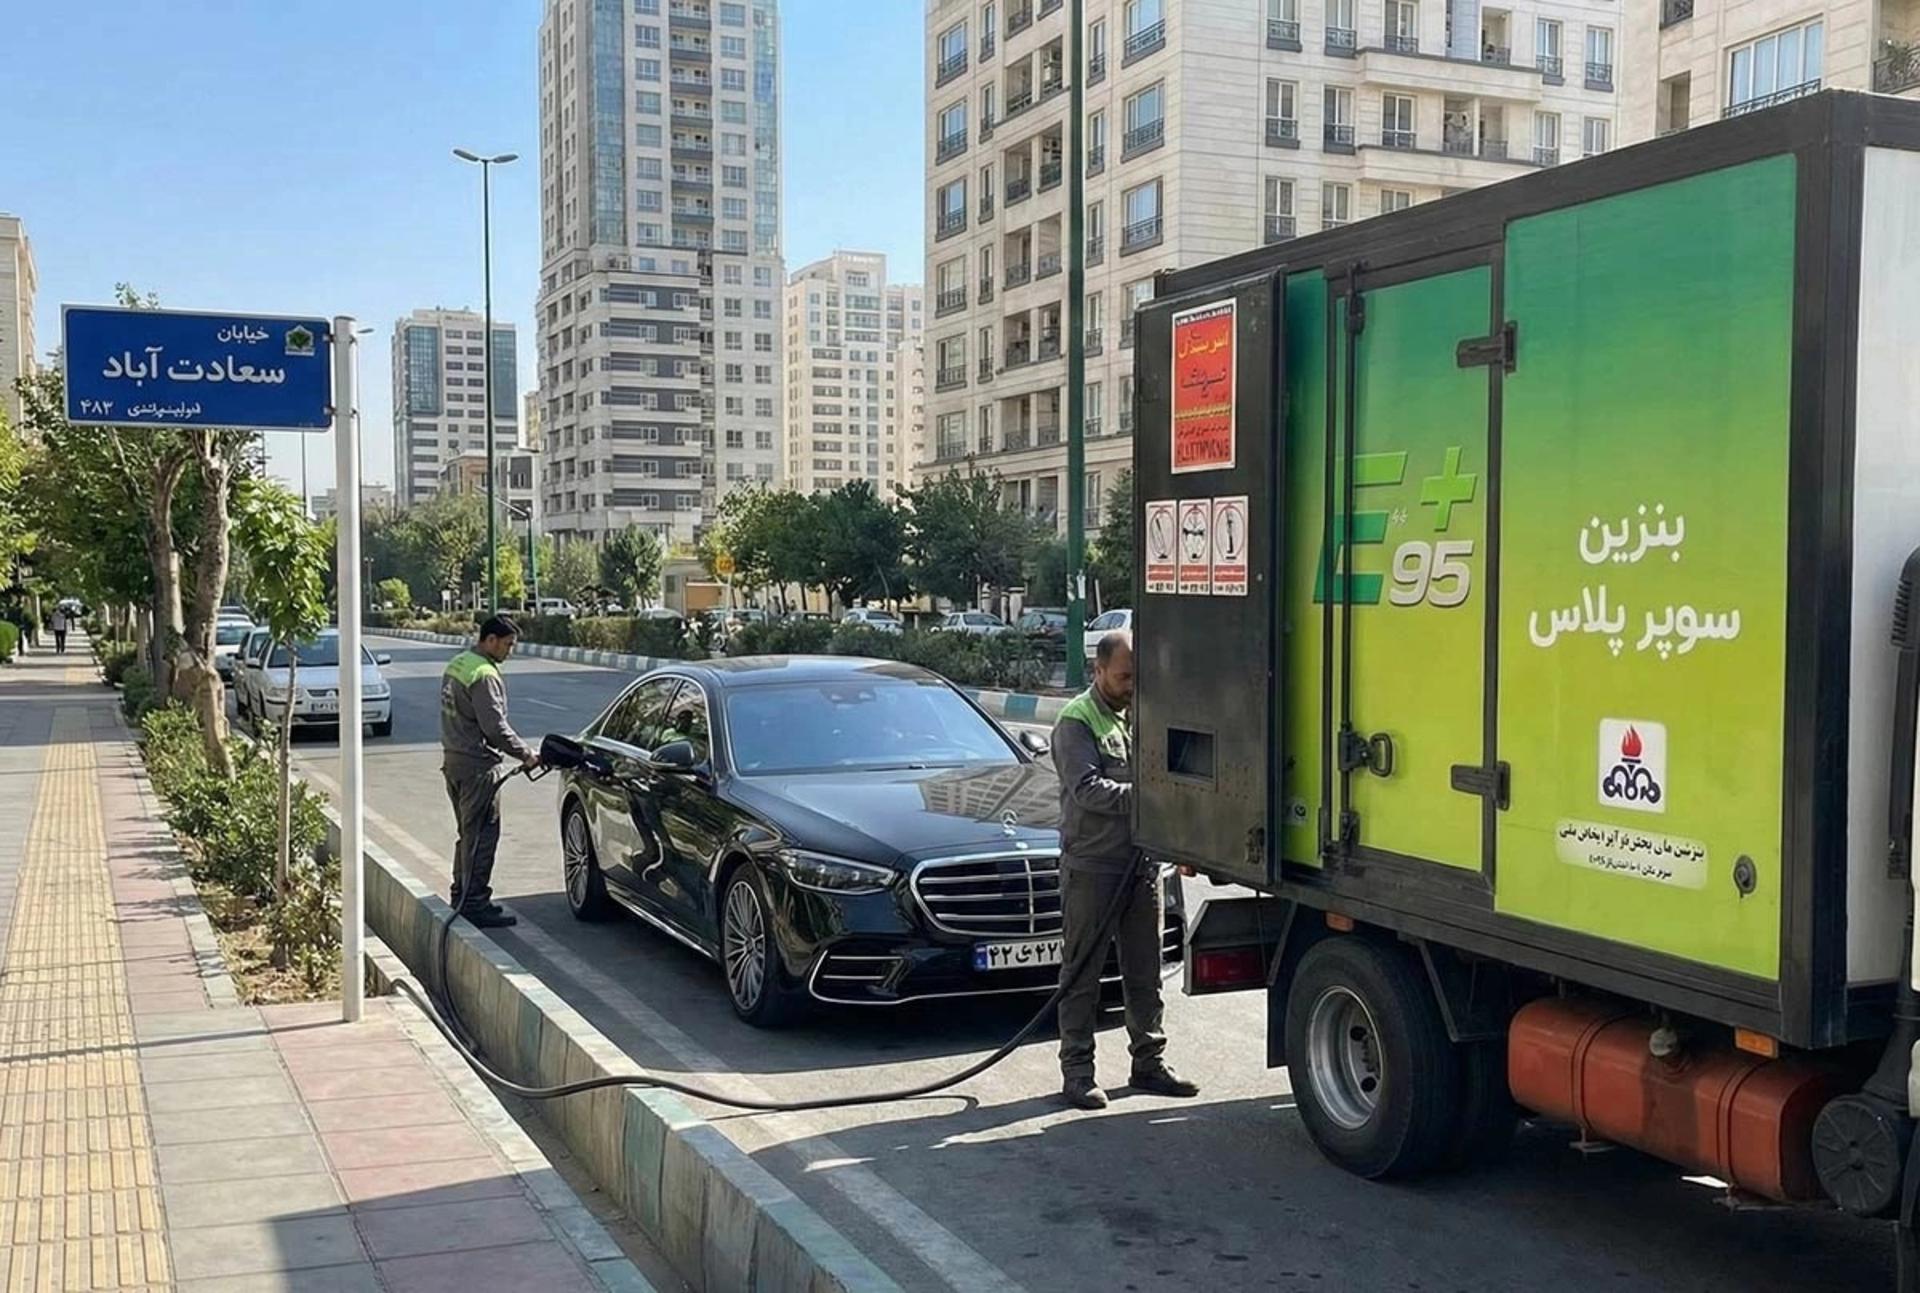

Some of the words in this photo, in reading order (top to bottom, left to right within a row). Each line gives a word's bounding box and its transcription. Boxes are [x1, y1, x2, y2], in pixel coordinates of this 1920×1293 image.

[217, 325, 269, 344] خیابان
[102, 346, 163, 386] آباد
[167, 355, 285, 384] سعادت
[1579, 503, 1685, 563] بنزین
[1388, 540, 1474, 608] 95
[1529, 585, 1626, 657] پلاس
[1637, 603, 1741, 659] سوپر
